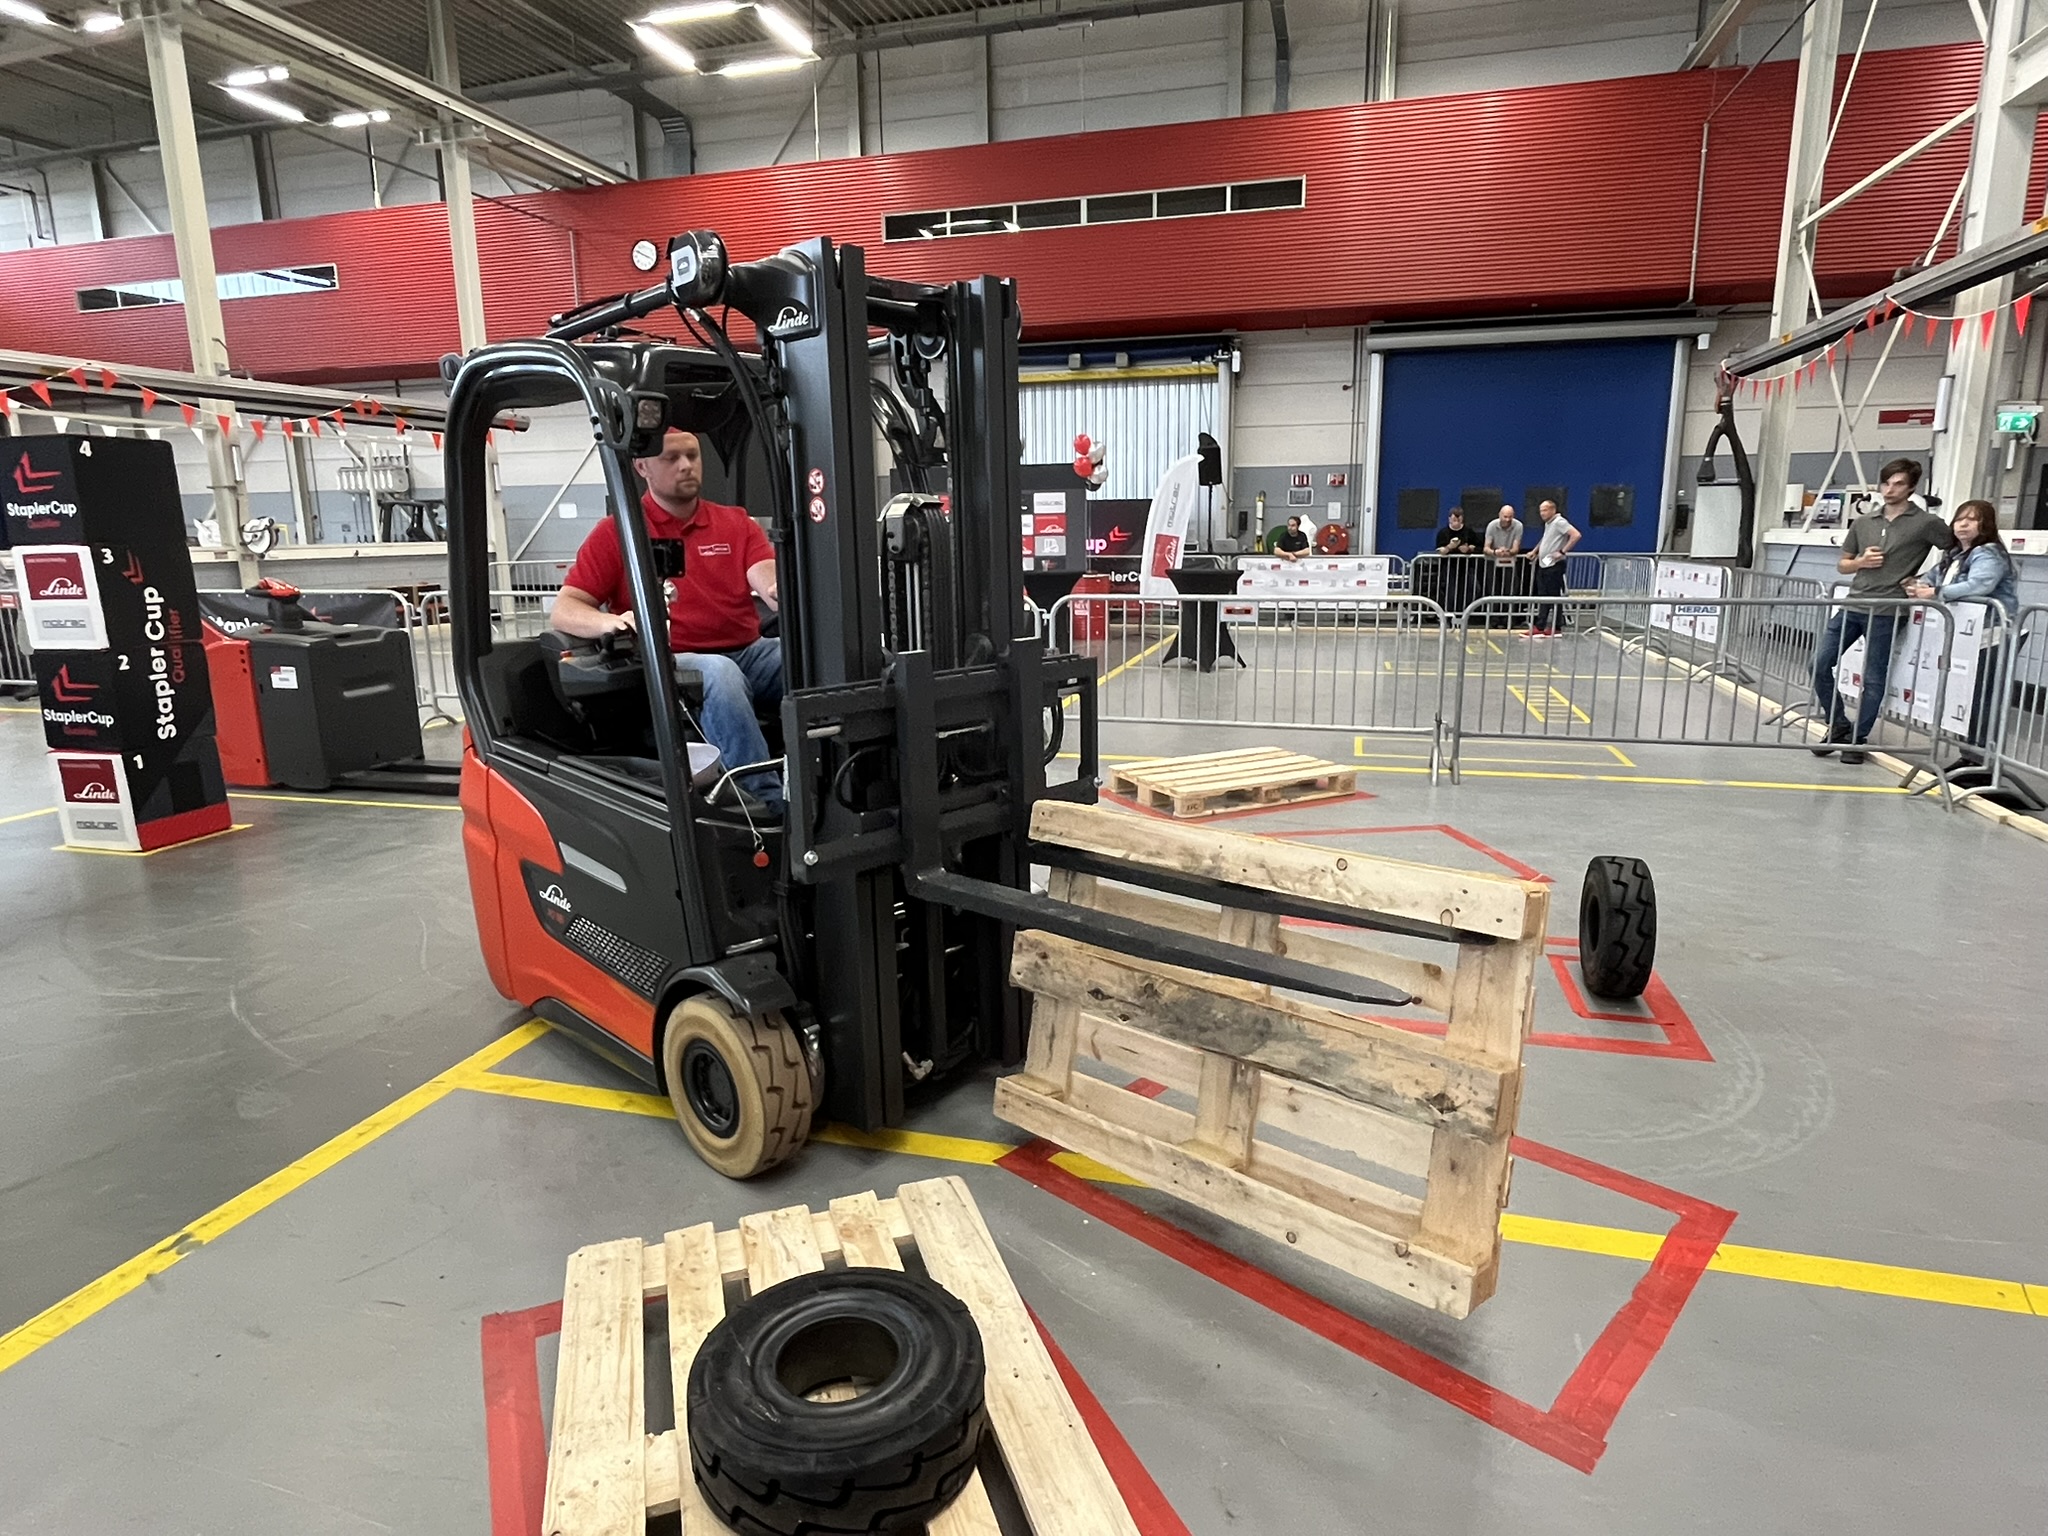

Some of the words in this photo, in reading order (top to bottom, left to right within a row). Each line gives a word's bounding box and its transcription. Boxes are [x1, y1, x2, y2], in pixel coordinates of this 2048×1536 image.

[767, 306, 810, 333] Linde
[79, 440, 93, 457] 4
[6, 500, 78, 519] StaplerCup
[101, 548, 115, 564] 3
[39, 577, 84, 596] Linde
[143, 586, 165, 641] Cup
[1677, 605, 1717, 613] HERAS
[168, 608, 186, 684] Qualifier
[117, 654, 131, 671] 2
[146, 646, 178, 740] Stapler
[43, 708, 115, 728] StaplerCup
[132, 754, 144, 770] 1
[73, 782, 117, 800] Linde
[539, 884, 572, 913] Linde
